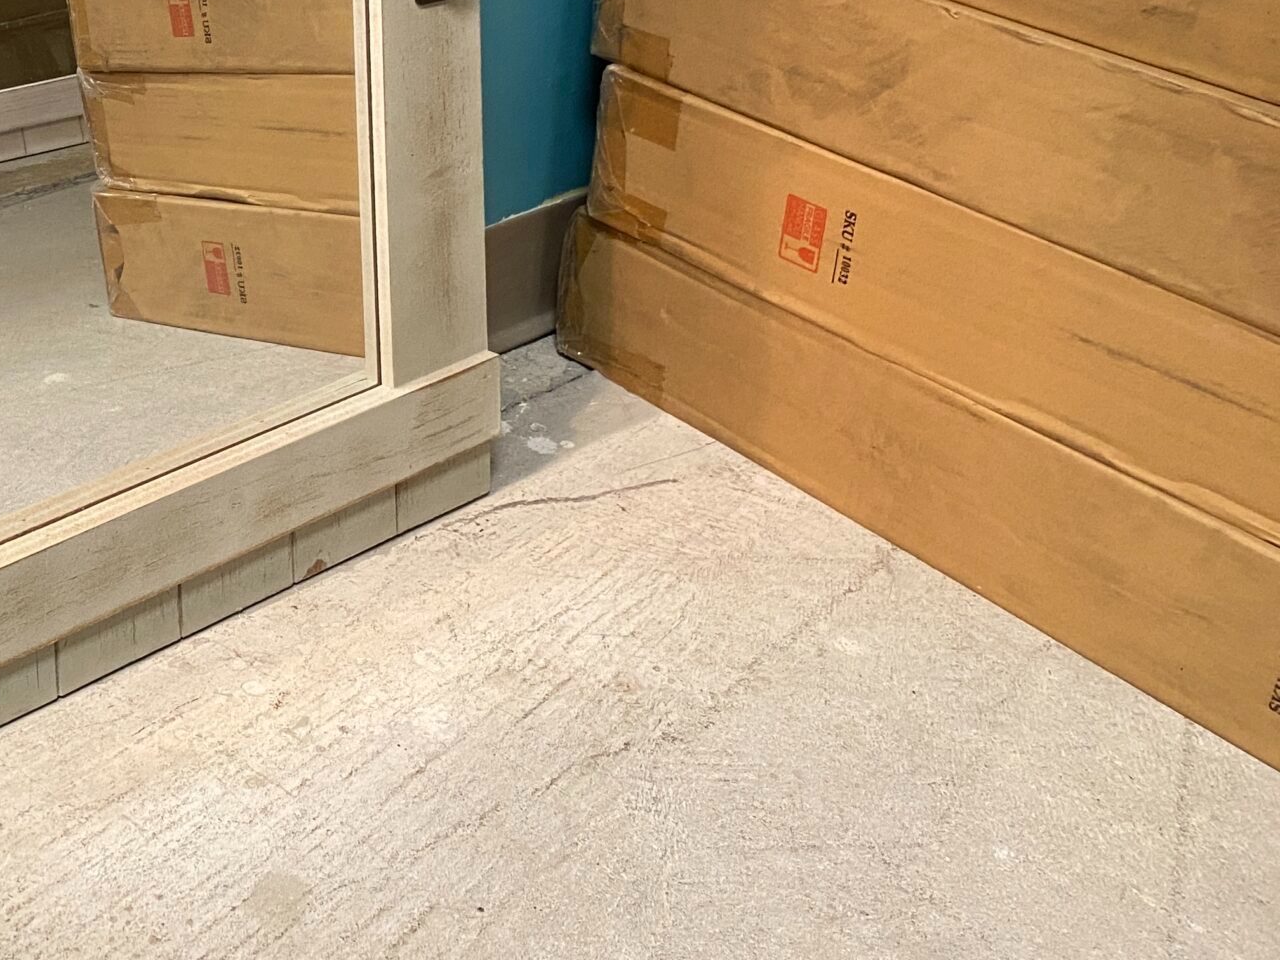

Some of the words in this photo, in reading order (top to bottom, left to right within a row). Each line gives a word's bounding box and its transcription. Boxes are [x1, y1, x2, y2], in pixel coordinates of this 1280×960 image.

[841, 209, 857, 243] SKU
[840, 243, 851, 252] #
[837, 255, 851, 285] 10032
